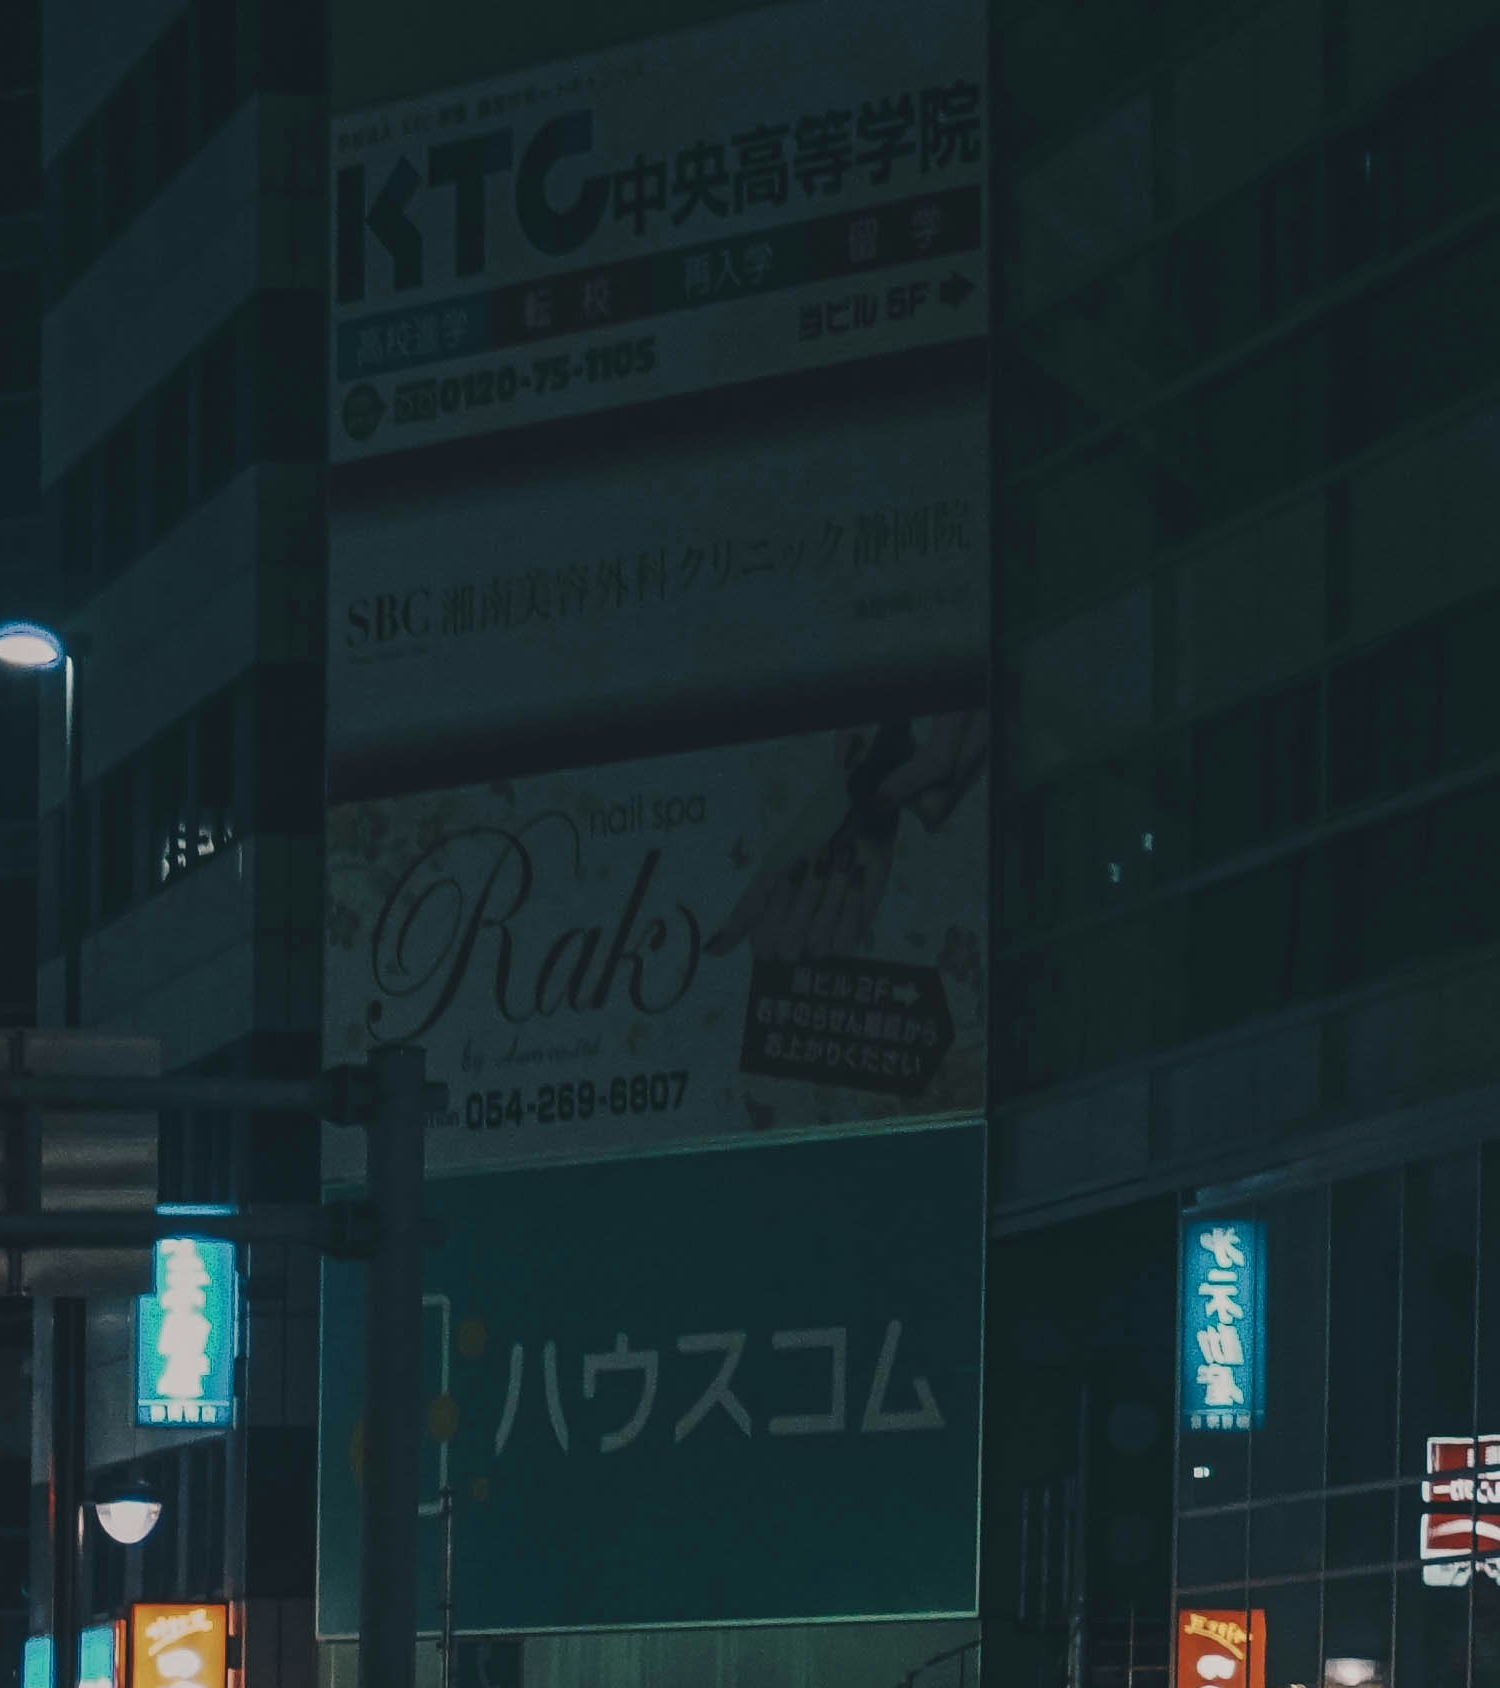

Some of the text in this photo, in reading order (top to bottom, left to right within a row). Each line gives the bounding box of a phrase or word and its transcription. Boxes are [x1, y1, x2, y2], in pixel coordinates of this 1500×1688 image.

[337, 108, 611, 304] KTC
[614, 80, 980, 238] 中央高等学院
[684, 242, 774, 298] 再入学
[346, 586, 431, 648] SBC
[652, 794, 707, 834] spa
[495, 1320, 948, 1455] ハウスコム
